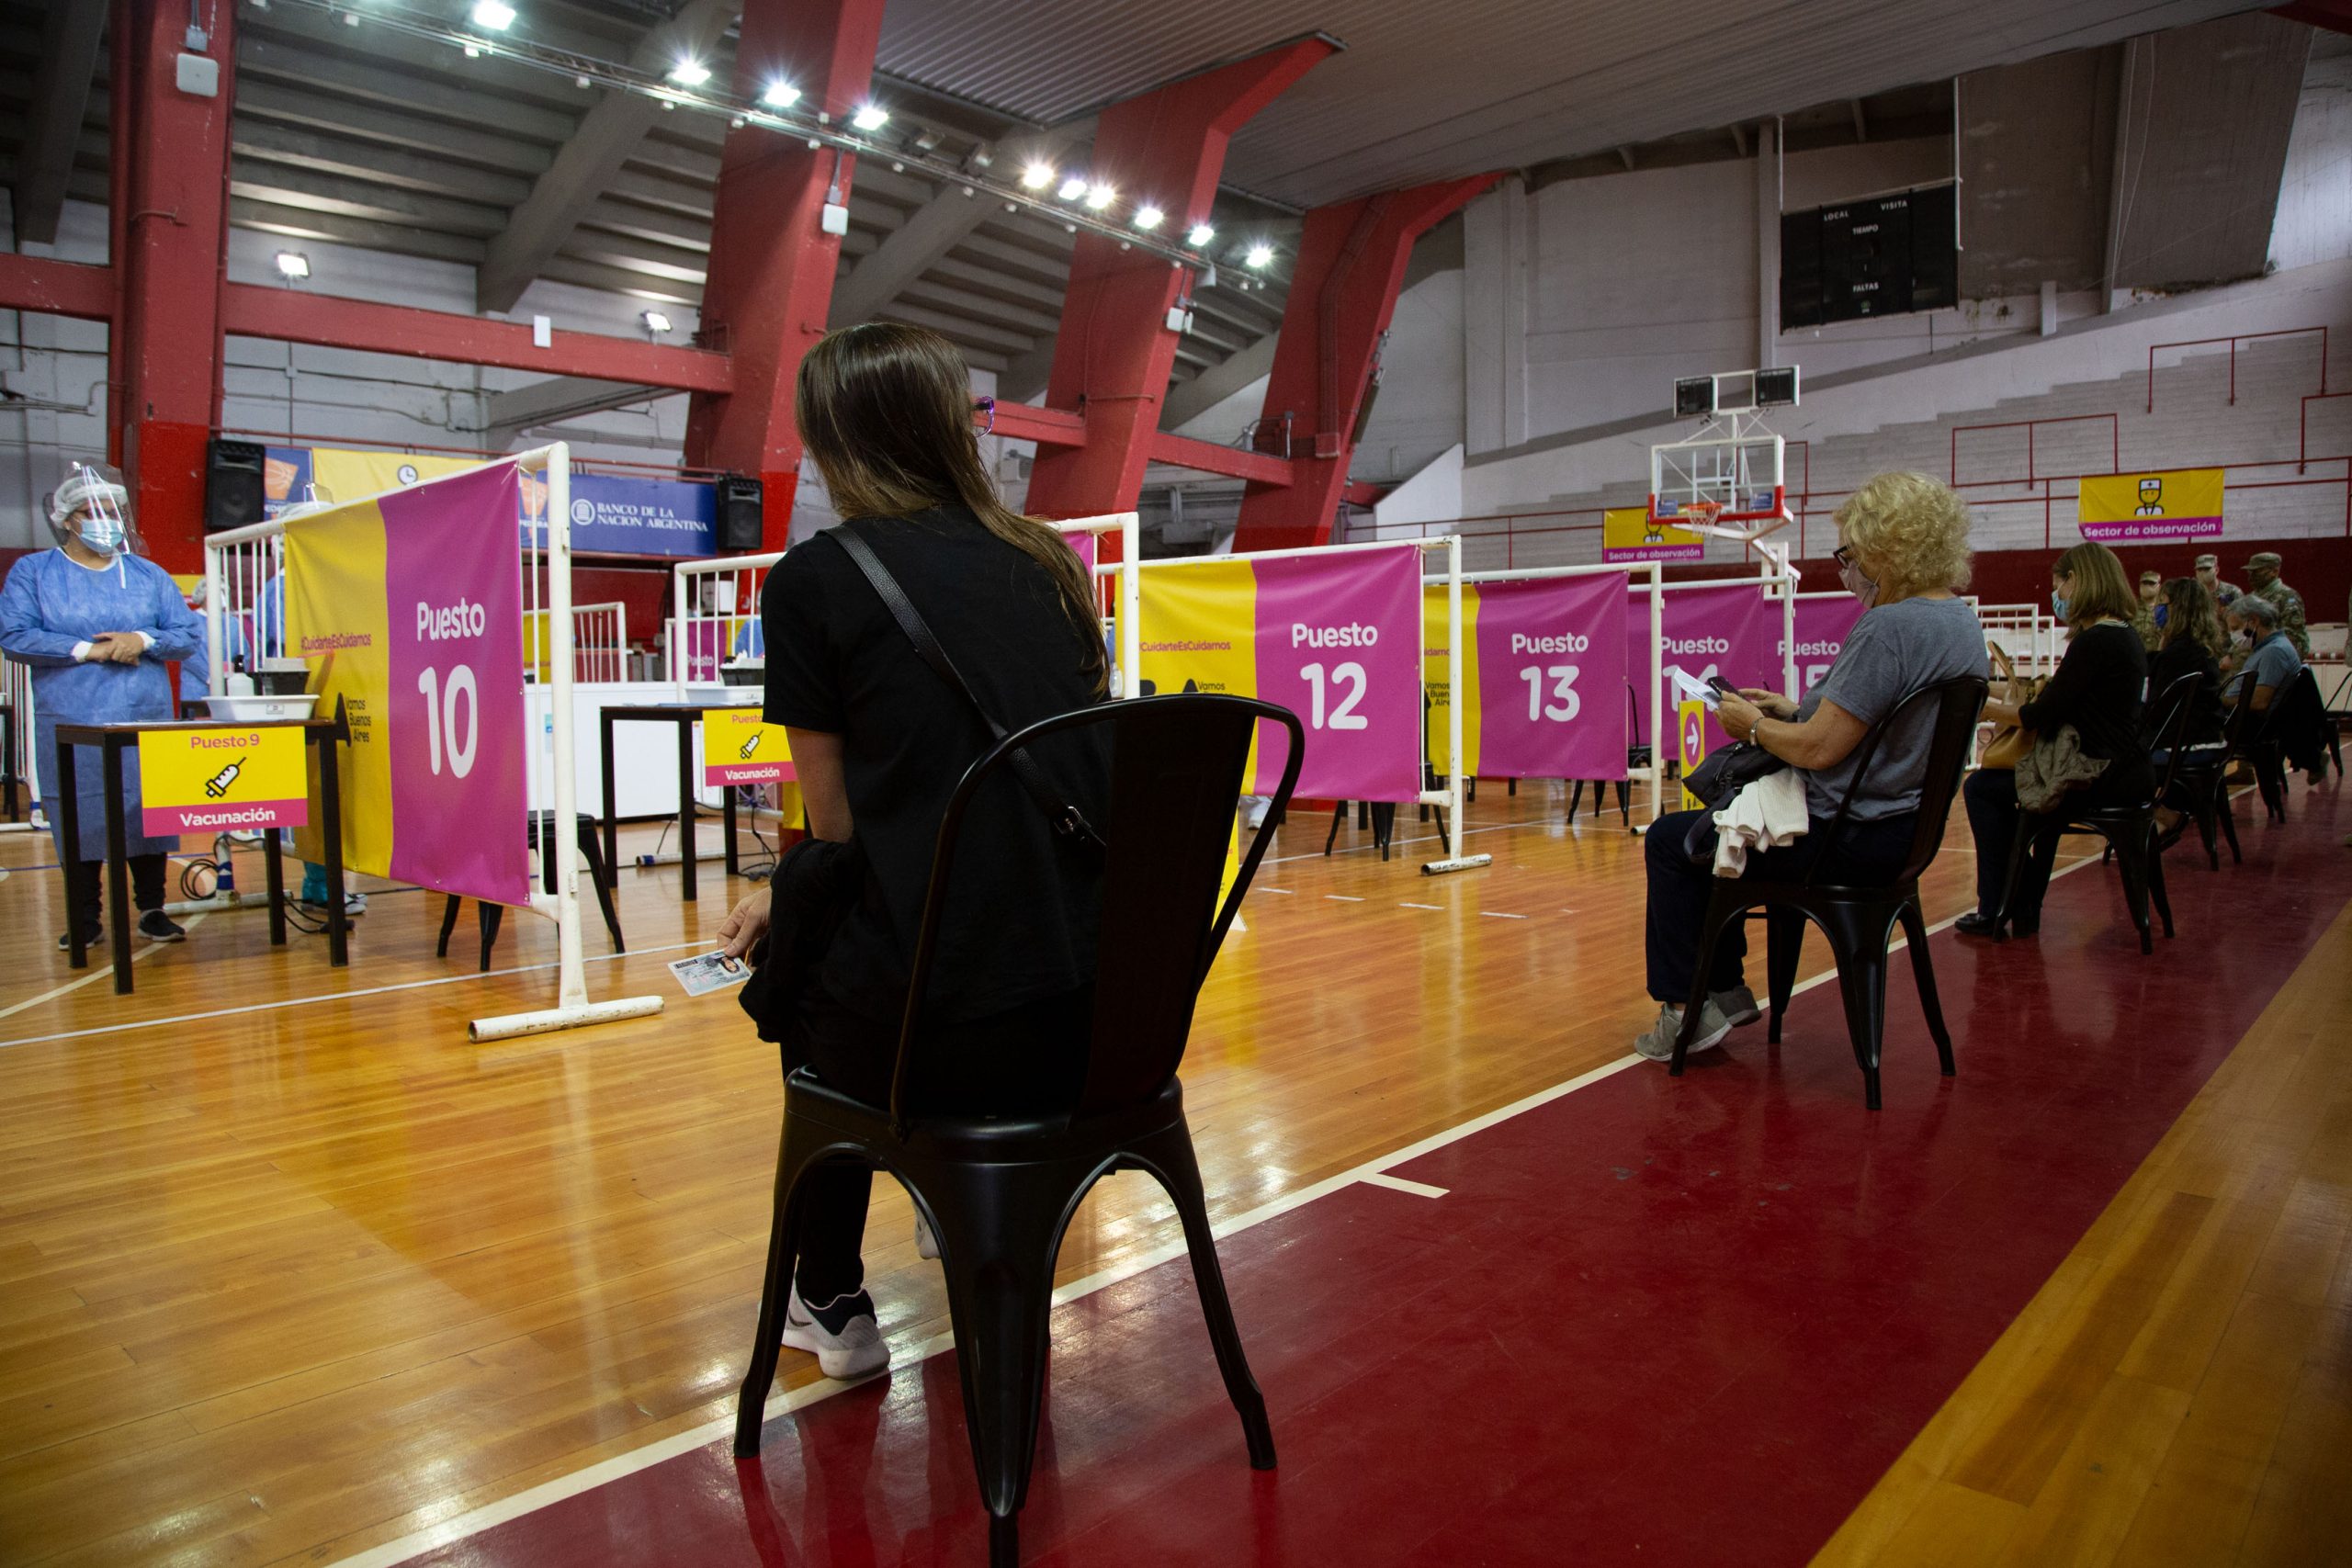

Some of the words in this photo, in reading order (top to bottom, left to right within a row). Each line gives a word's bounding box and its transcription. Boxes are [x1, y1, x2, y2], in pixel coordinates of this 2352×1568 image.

[1881, 200, 1907, 210] VISITA
[1824, 210, 1849, 221] LOCAL
[1852, 224, 1879, 235] TIEMPO
[1852, 282, 1879, 293] FALTAS
[597, 502, 638, 515] BANCO
[642, 505, 654, 516] DE
[660, 507, 674, 518] LA
[598, 514, 642, 527] NACION
[646, 519, 708, 532] ARGENTINA
[2084, 526, 2121, 537] Sector
[2124, 525, 2139, 535] de
[2143, 521, 2216, 535] observación
[1609, 551, 1634, 560] Sector
[1637, 550, 1646, 558] de
[1649, 548, 1700, 558] observación
[417, 597, 485, 641] Puesto
[1292, 621, 1378, 649] Puesto
[1511, 632, 1589, 654] Puesto
[1139, 640, 1231, 652] CuidarteEsCuidamos
[1661, 636, 1729, 655] Puesto
[1197, 681, 1226, 690] Vamos
[1520, 665, 1580, 722] 13
[1300, 661, 1368, 729] 12
[418, 664, 478, 779] 10
[191, 736, 247, 749] Puesto
[250, 734, 260, 746] 9
[725, 767, 779, 781] Vacunación
[179, 807, 276, 827] Vacunación
